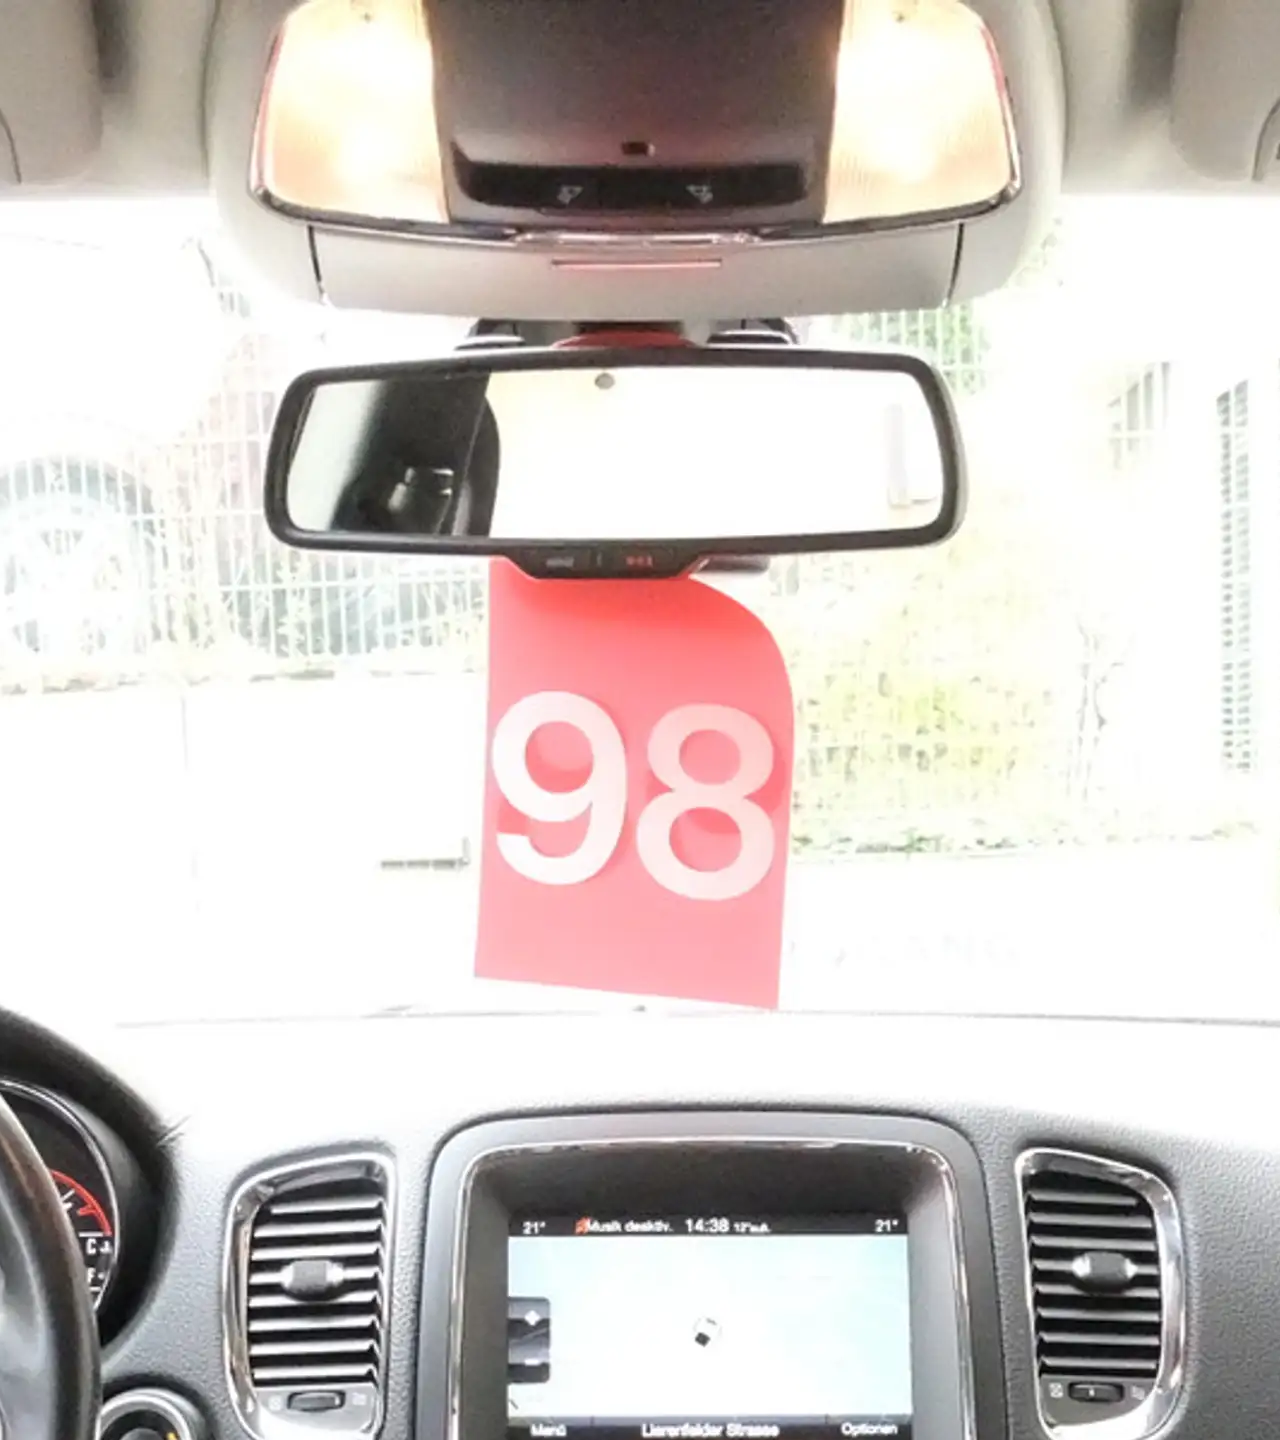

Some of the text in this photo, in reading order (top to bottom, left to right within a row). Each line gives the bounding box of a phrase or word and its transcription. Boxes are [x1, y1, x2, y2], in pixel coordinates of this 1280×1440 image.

[491, 690, 775, 901] 98
[684, 1217, 730, 1233] 14:38
[86, 1238, 97, 1255] C
[725, 1422, 781, 1438] Strasse
[840, 1421, 899, 1438] Optionen
